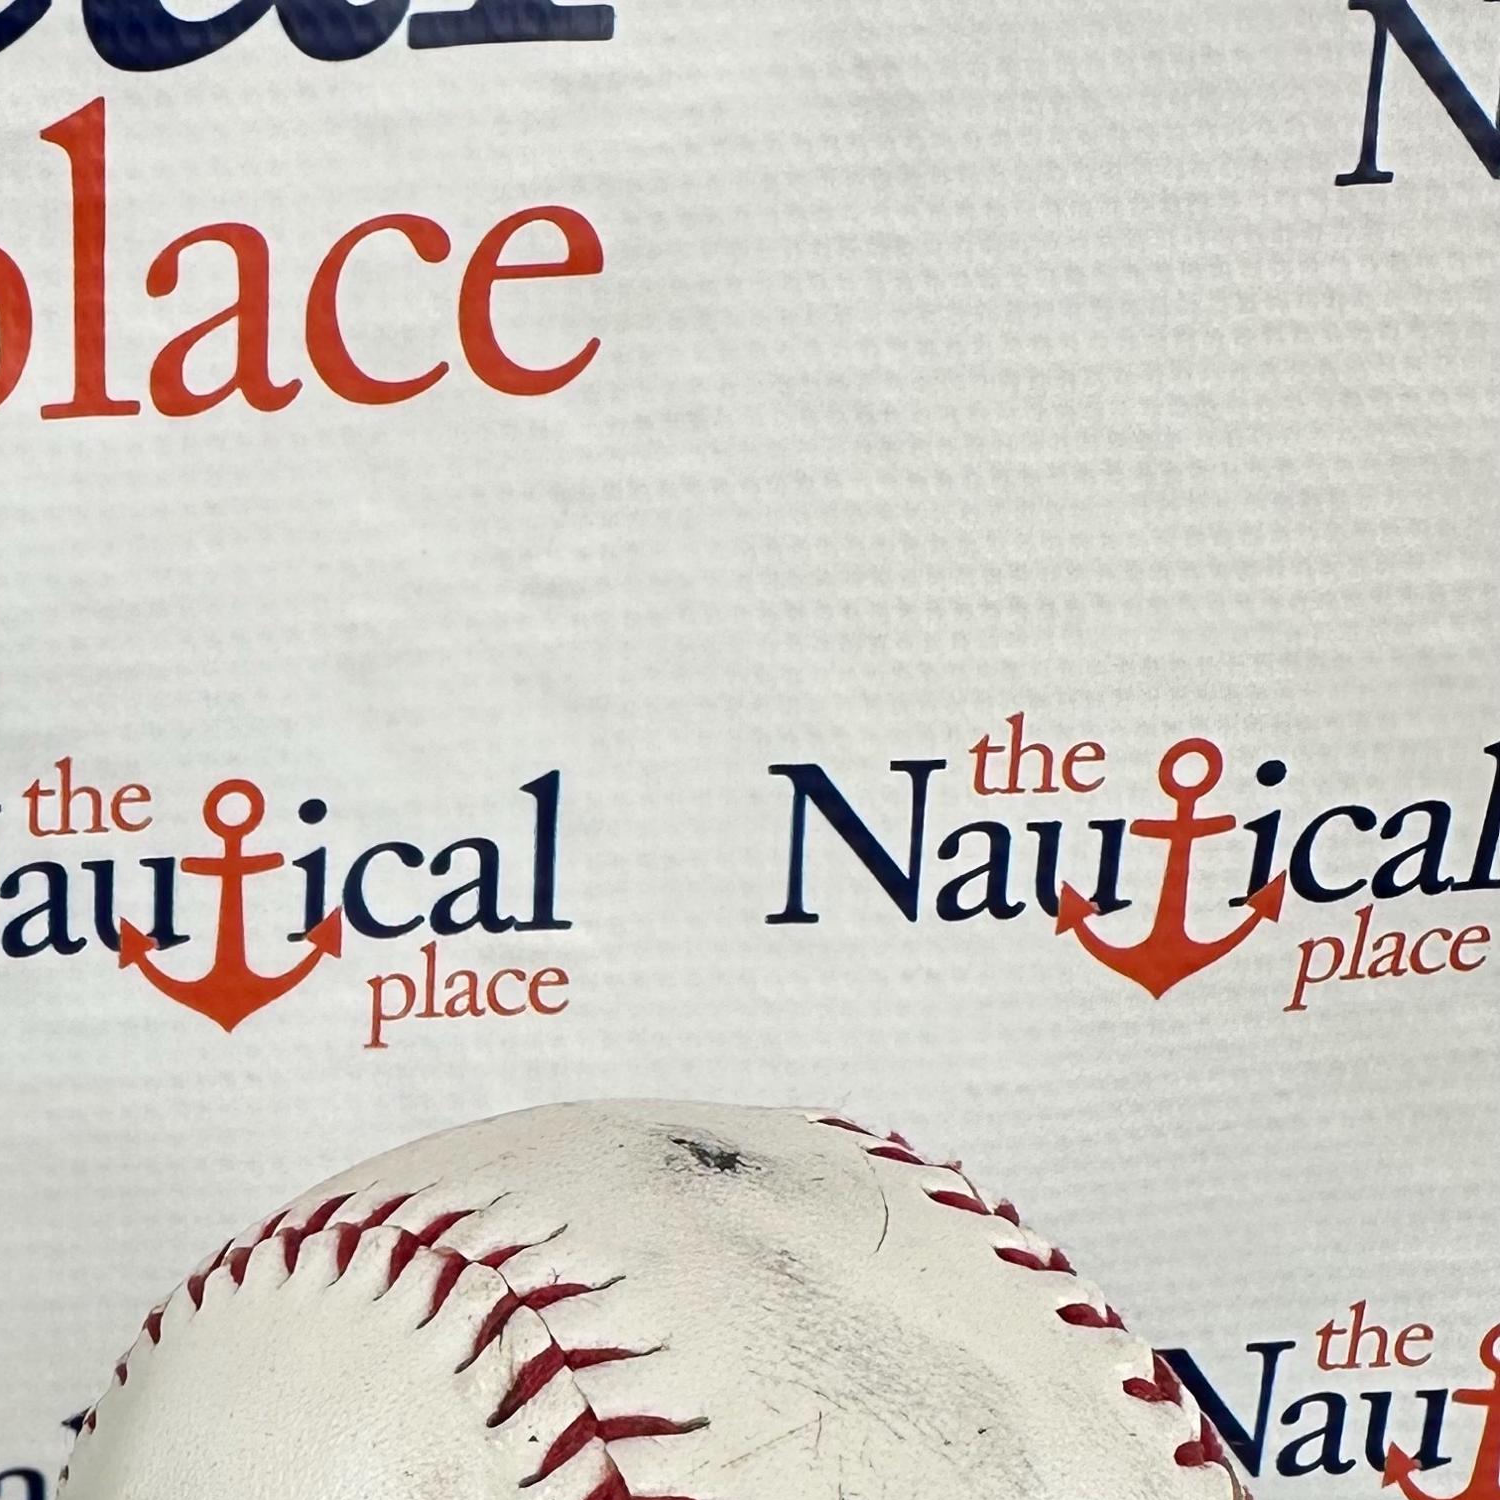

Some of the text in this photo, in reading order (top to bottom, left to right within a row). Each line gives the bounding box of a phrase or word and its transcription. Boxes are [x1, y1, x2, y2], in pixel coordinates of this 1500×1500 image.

[969, 711, 1106, 796] the
[22, 756, 153, 838] the
[363, 942, 570, 1048] place
[1283, 903, 1491, 1012] place
[1316, 1299, 1434, 1371] the
